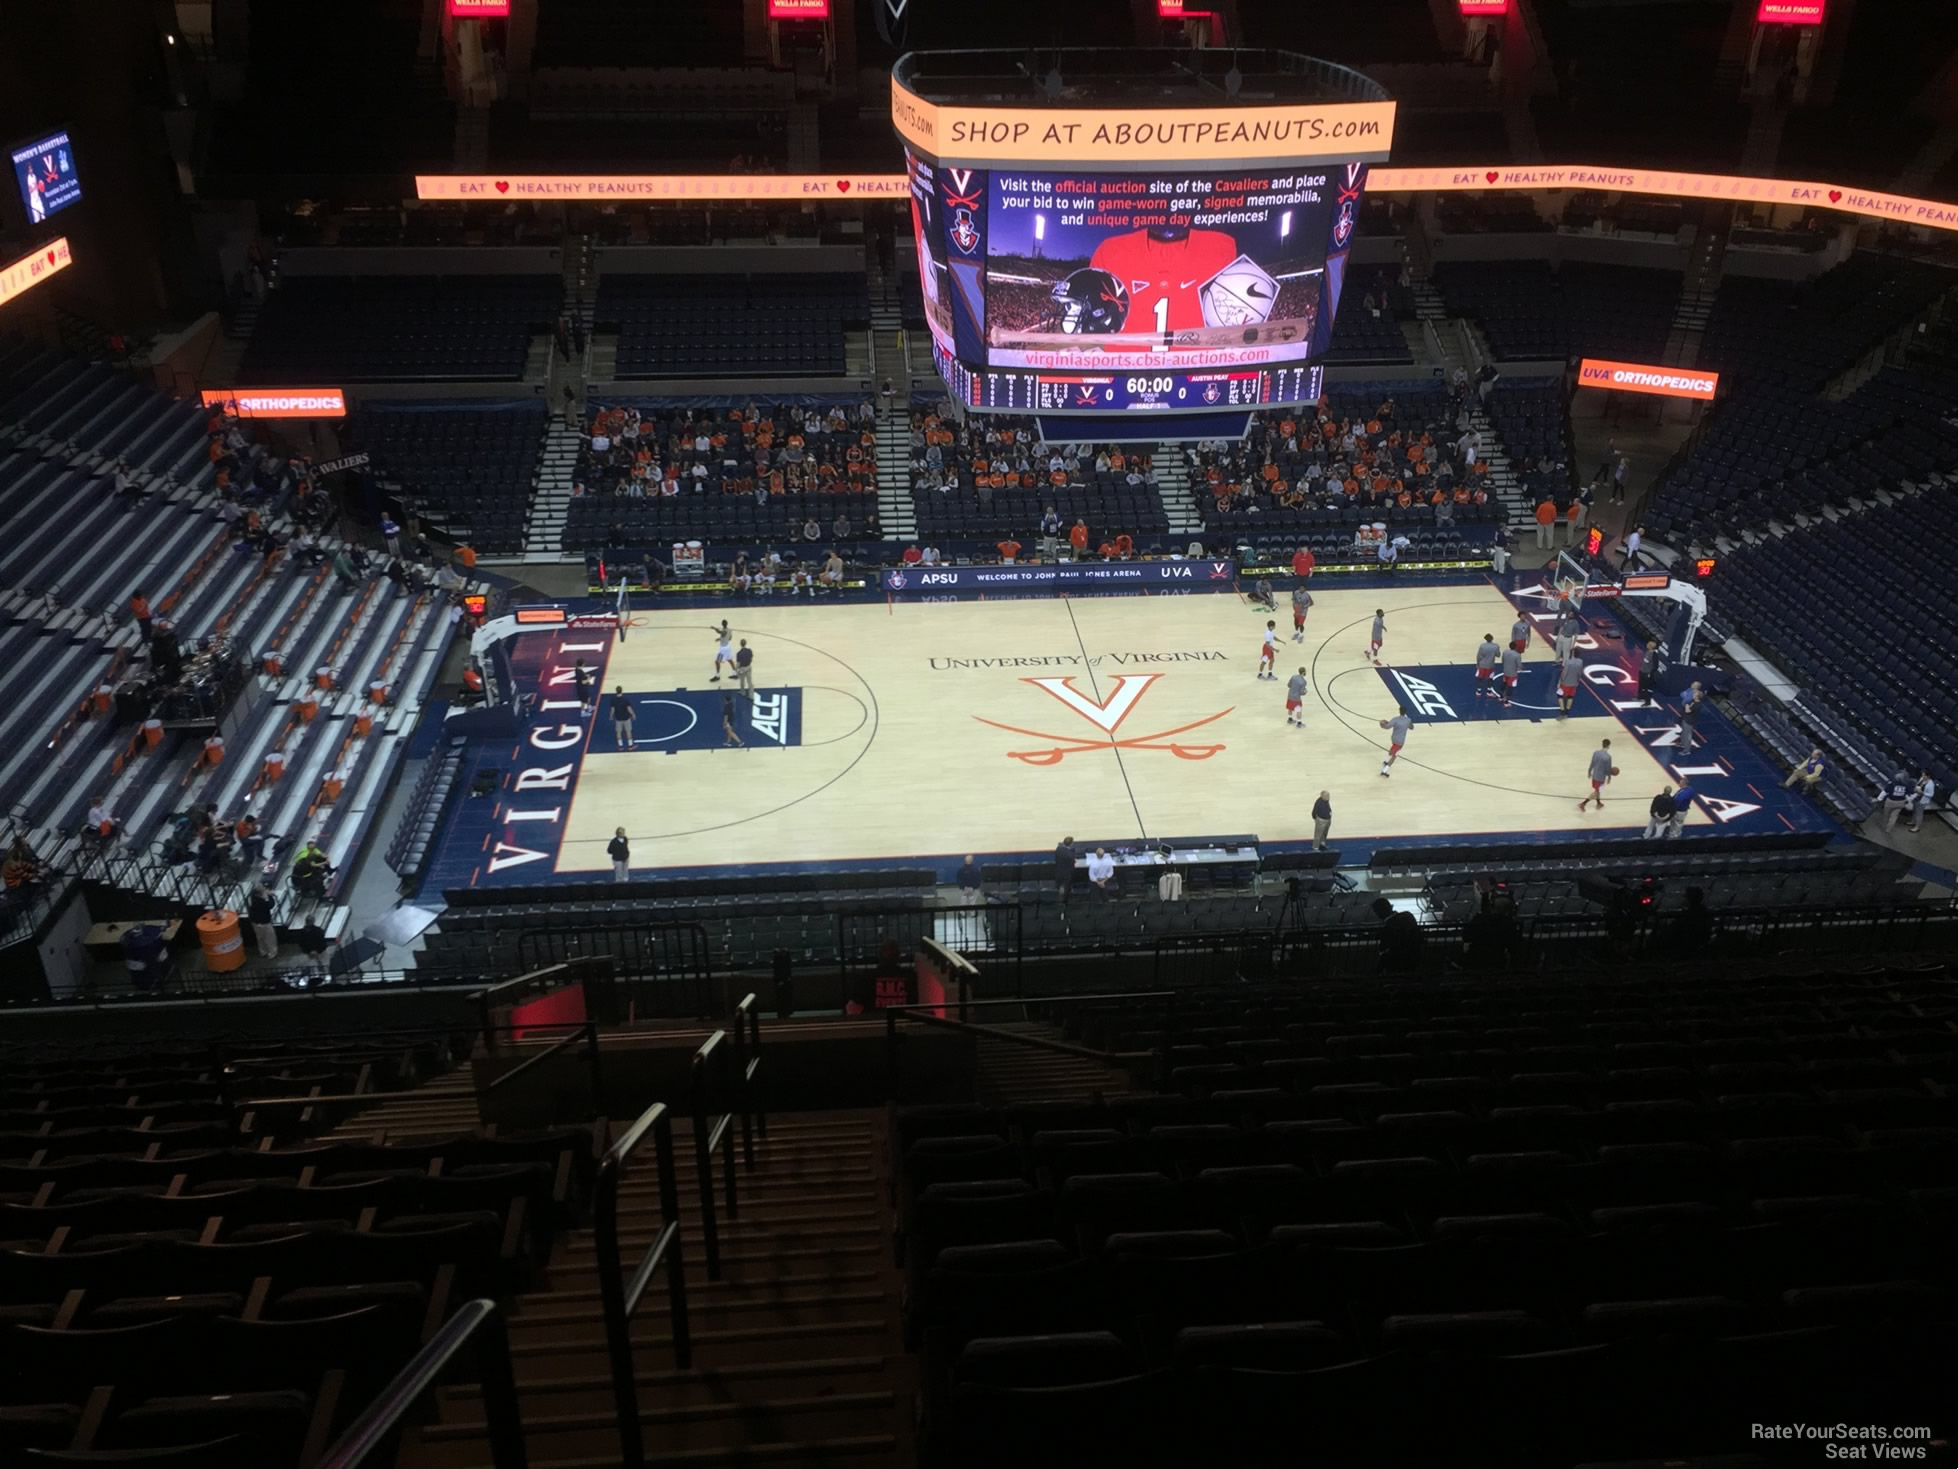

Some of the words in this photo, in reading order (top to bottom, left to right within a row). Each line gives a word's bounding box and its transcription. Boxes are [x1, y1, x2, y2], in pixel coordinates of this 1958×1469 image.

[1765, 4, 1792, 14] WELLS
[1793, 5, 1819, 14] FARGO
[951, 120, 1030, 143] SHOP
[1042, 123, 1082, 144] AT
[1092, 118, 1380, 145] ABOUTPEANUTS.com
[802, 182, 830, 192] EAT
[1000, 178, 1028, 193] Visit
[1031, 179, 1051, 192] the
[1055, 179, 1097, 193] official
[1100, 180, 1146, 193] auction
[1150, 180, 1172, 193] site
[1176, 180, 1190, 193] of
[1192, 180, 1212, 193] the
[1215, 178, 1269, 191] Cavaliers
[1272, 176, 1293, 189] and
[1296, 174, 1326, 188] place
[1453, 174, 1479, 184] EAT
[1504, 172, 1566, 184] HEALTHY
[1569, 172, 1635, 186] PEANUTS
[459, 183, 488, 193] EAT
[516, 183, 582, 193] HEALTHY
[588, 183, 654, 193] PEANUTS
[1002, 197, 1030, 209] your
[1034, 196, 1053, 208] bid
[1056, 197, 1069, 209] to
[1073, 197, 1095, 209] win
[1098, 198, 1168, 211] game-worn
[1170, 197, 1201, 212] gear,
[1204, 196, 1244, 210] signed
[1247, 190, 1321, 206] memorabilia,
[1791, 187, 1822, 199] EAT
[1847, 195, 1913, 214] HEALTHY
[1916, 206, 1958, 222] PEAN
[1061, 214, 1084, 225] and
[1087, 214, 1129, 227] unique
[1132, 215, 1166, 227] game
[1169, 214, 1191, 227] day
[1194, 210, 1269, 225] experiences!
[30, 258, 46, 276] EAT
[1025, 347, 1270, 369] virginiasports.cbsi-auctions.com
[1126, 377, 1173, 393] 60:00
[1583, 367, 1610, 380] UVA
[1614, 370, 1714, 392] ORTHOPEDICS
[1105, 389, 1113, 400] 0
[1178, 388, 1186, 399] 0
[239, 397, 342, 410] ORTHOPEDICS
[921, 573, 958, 584] APSU
[977, 573, 1018, 581] WELCOME
[1161, 567, 1192, 578] UVA
[1699, 567, 1710, 575] 30
[928, 655, 1084, 671] UNIVERSITY
[1088, 655, 1104, 667] of
[1108, 650, 1230, 666] VIRGINIA
[1396, 671, 1458, 719] ACC
[752, 692, 784, 743] ACC
[487, 639, 605, 874] VIRGINI
